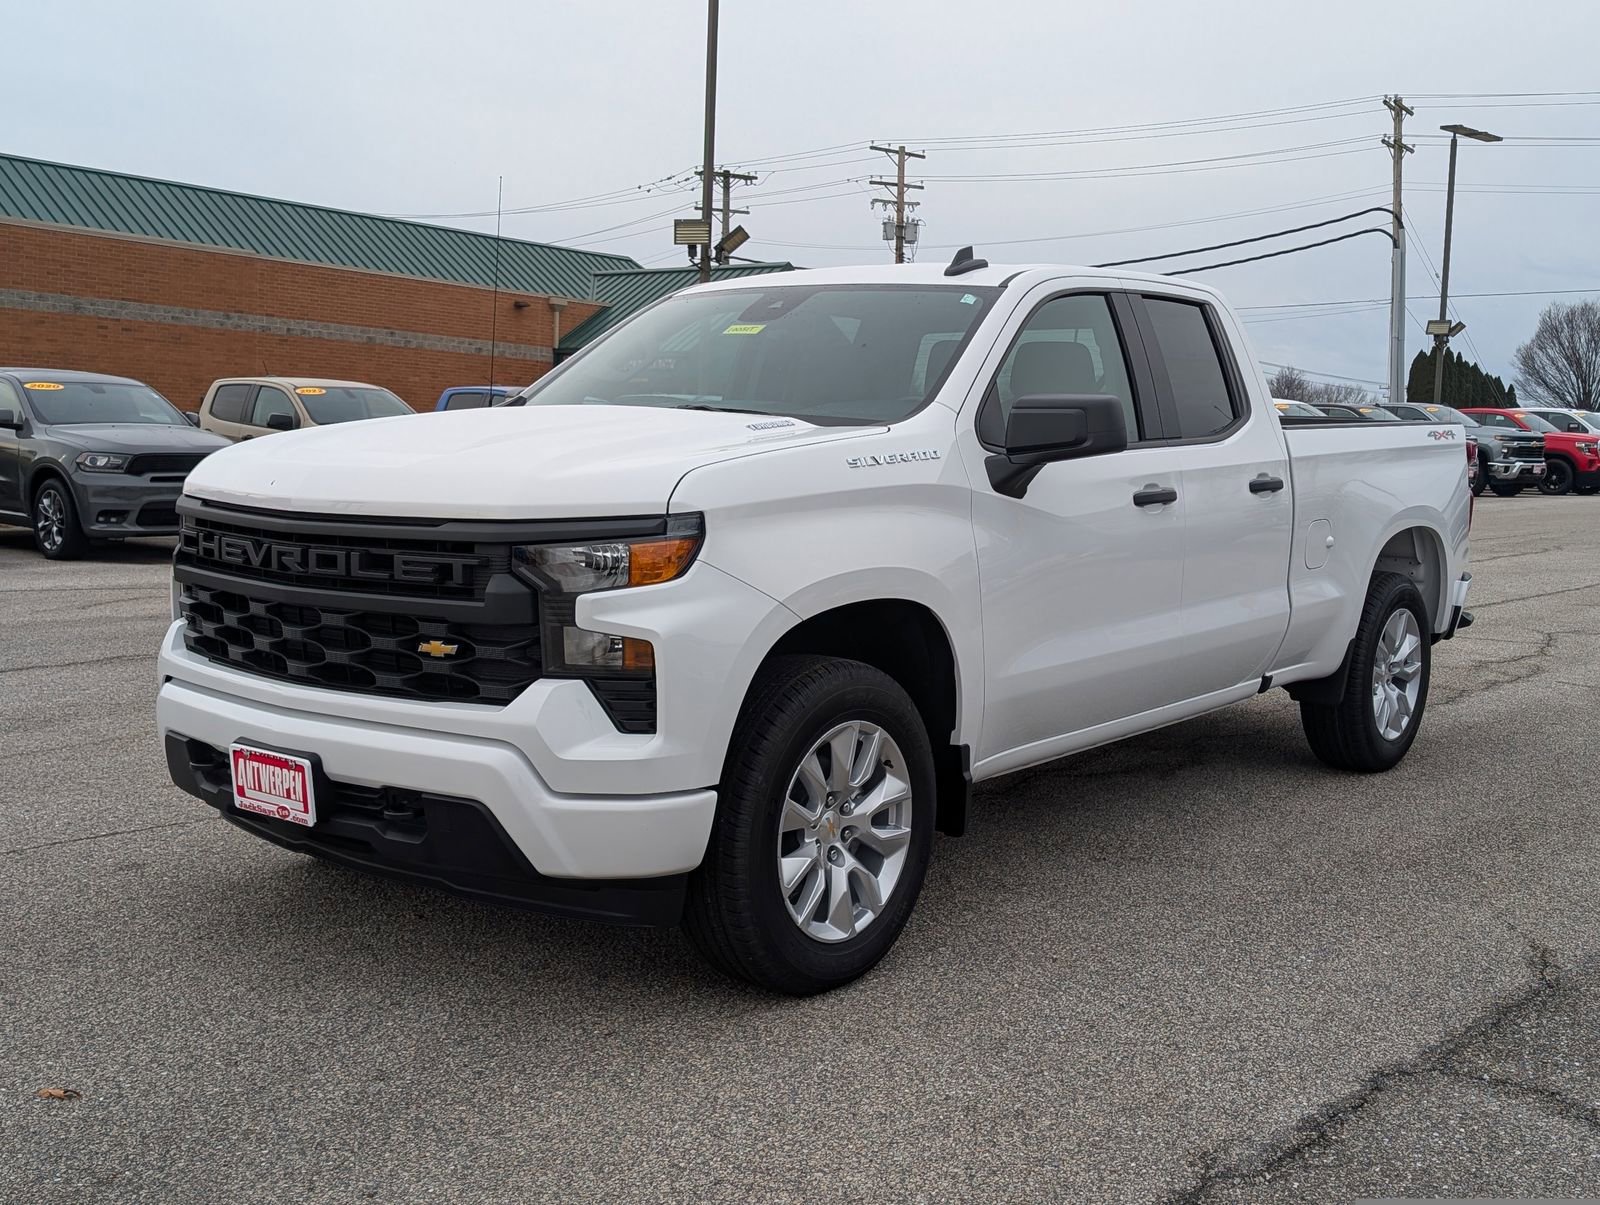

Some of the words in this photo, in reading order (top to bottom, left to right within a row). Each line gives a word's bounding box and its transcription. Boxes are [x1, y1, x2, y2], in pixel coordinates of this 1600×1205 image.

[846, 449, 941, 468] SILVERADO
[180, 528, 486, 585] CHEVROLET
[238, 758, 303, 801] ANTWERPEN
